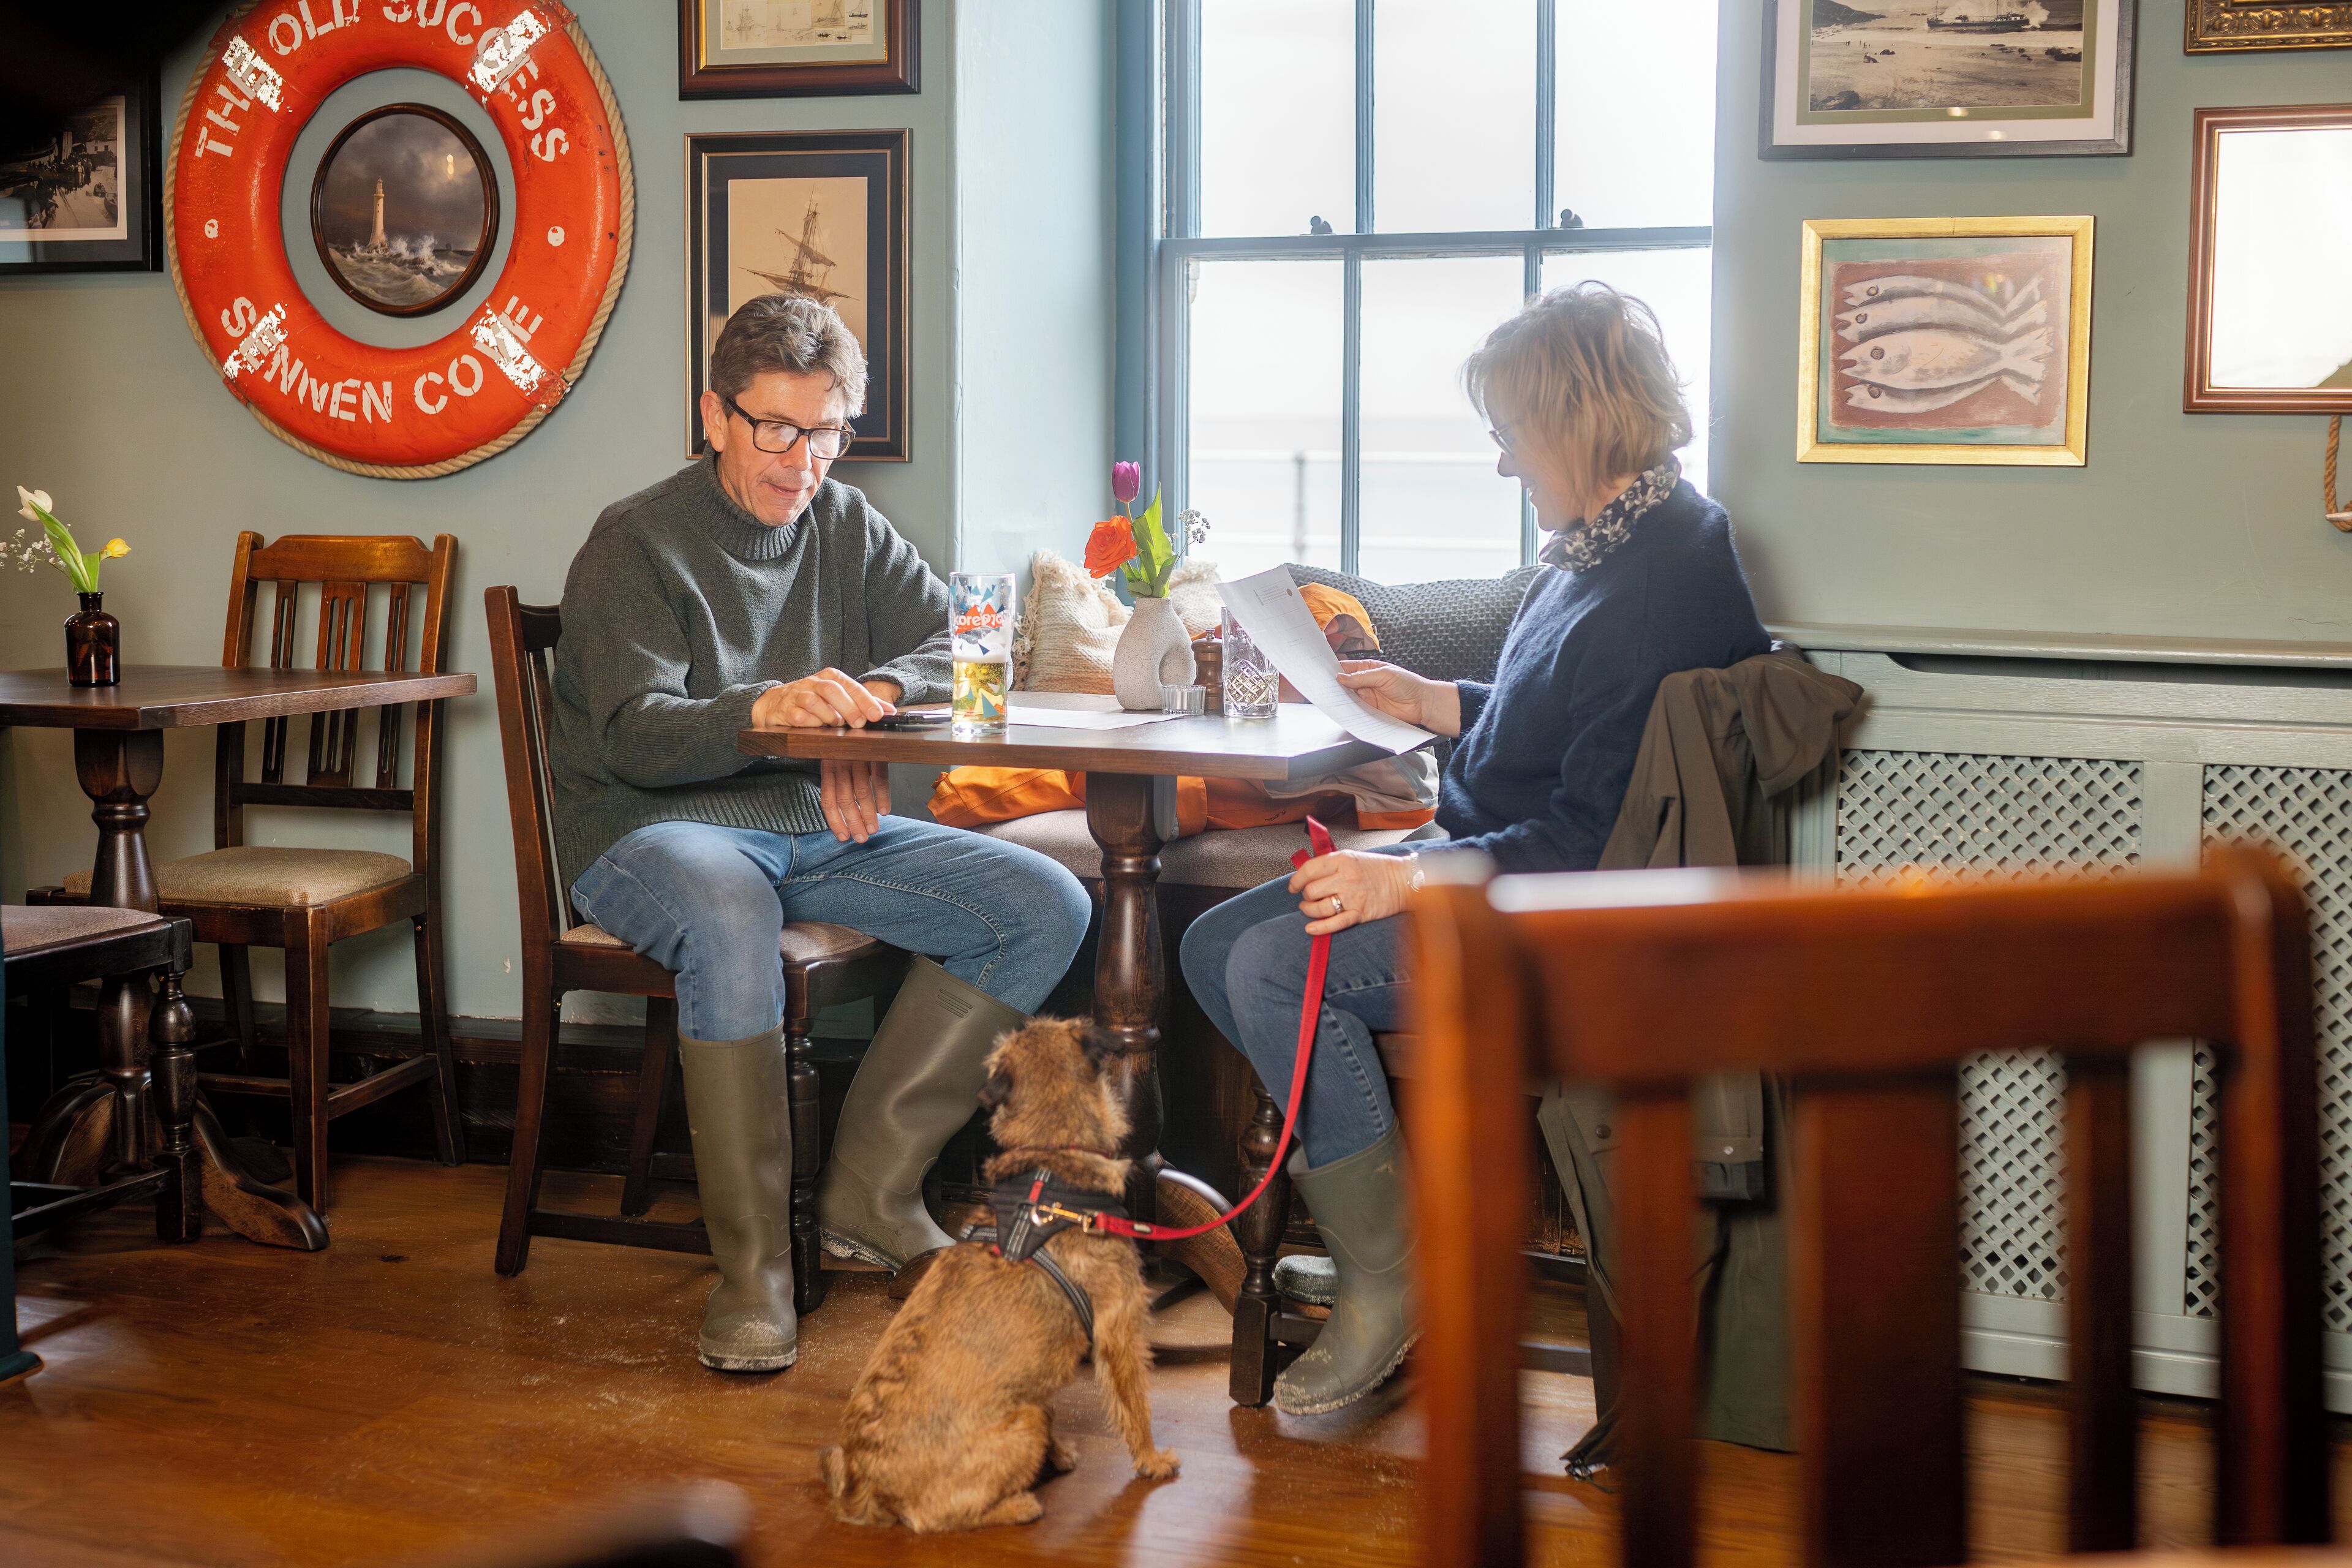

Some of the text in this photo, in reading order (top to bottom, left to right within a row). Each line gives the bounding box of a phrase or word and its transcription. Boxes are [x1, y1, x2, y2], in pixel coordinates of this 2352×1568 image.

[195, 0, 570, 162] THE OLD SUCCESS
[221, 295, 543, 424] SENNEN COVE
